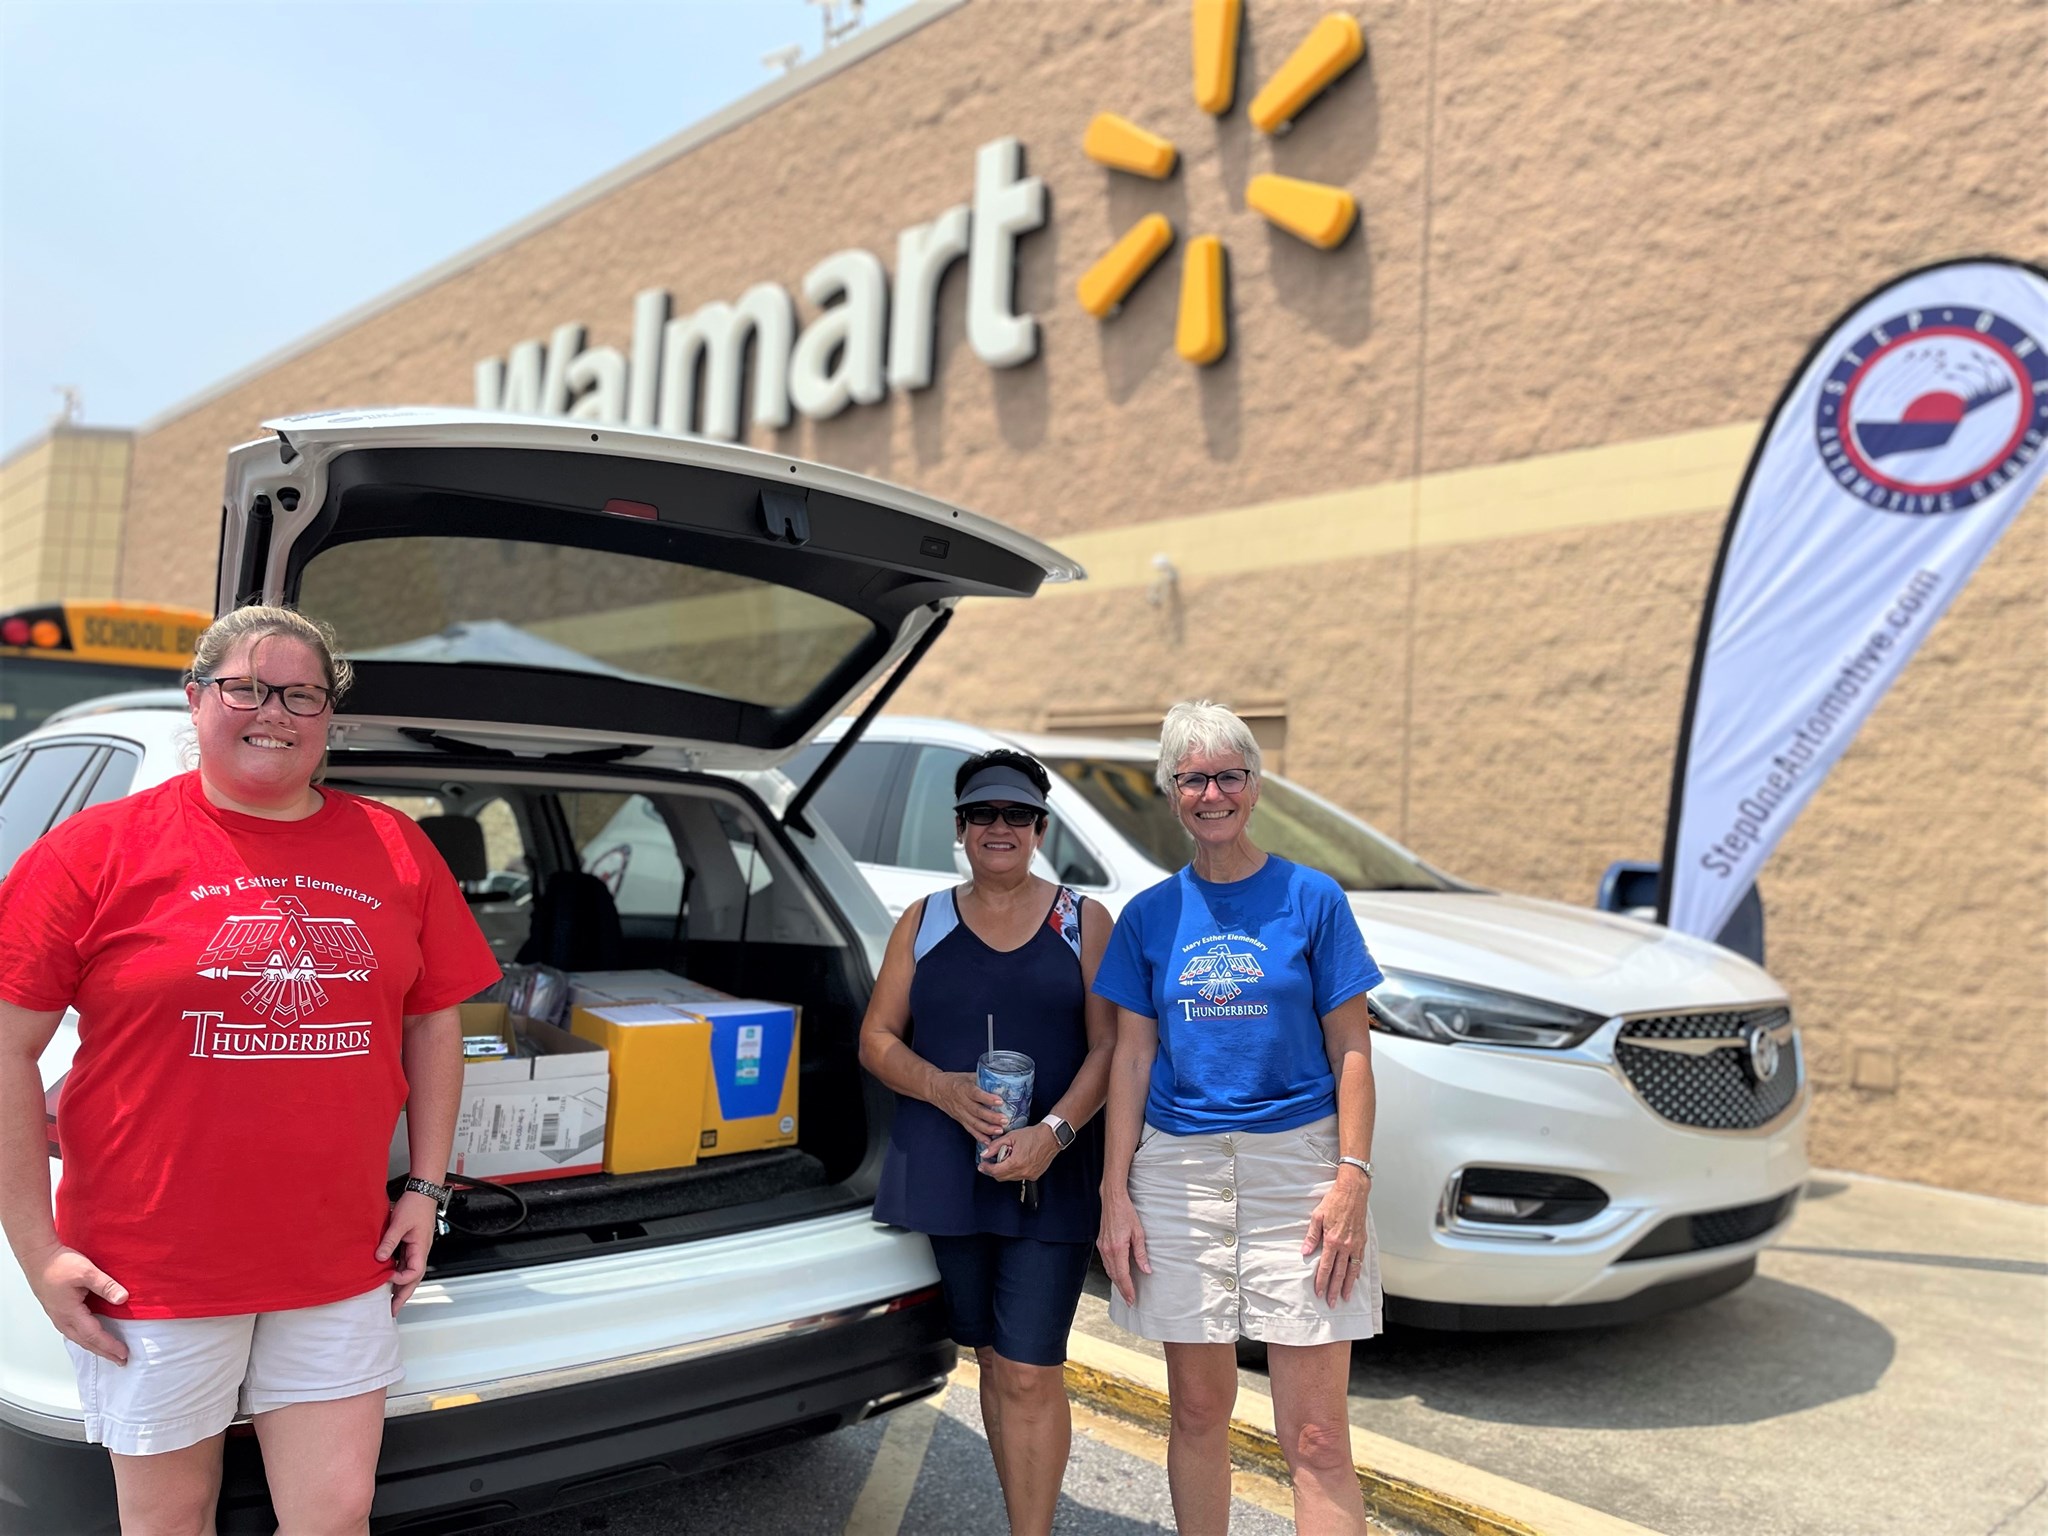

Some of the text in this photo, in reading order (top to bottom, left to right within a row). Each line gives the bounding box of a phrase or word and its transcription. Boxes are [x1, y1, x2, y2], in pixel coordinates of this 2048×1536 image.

[474, 137, 1044, 439] Walmart
[1823, 310, 1923, 396] STEP
[85, 616, 164, 651] SCHOOL
[1701, 568, 1941, 880] StepOneAutomotive.com
[189, 875, 382, 910] Mary Esther Elementary
[1181, 934, 1268, 953] Mary Esther Elementary
